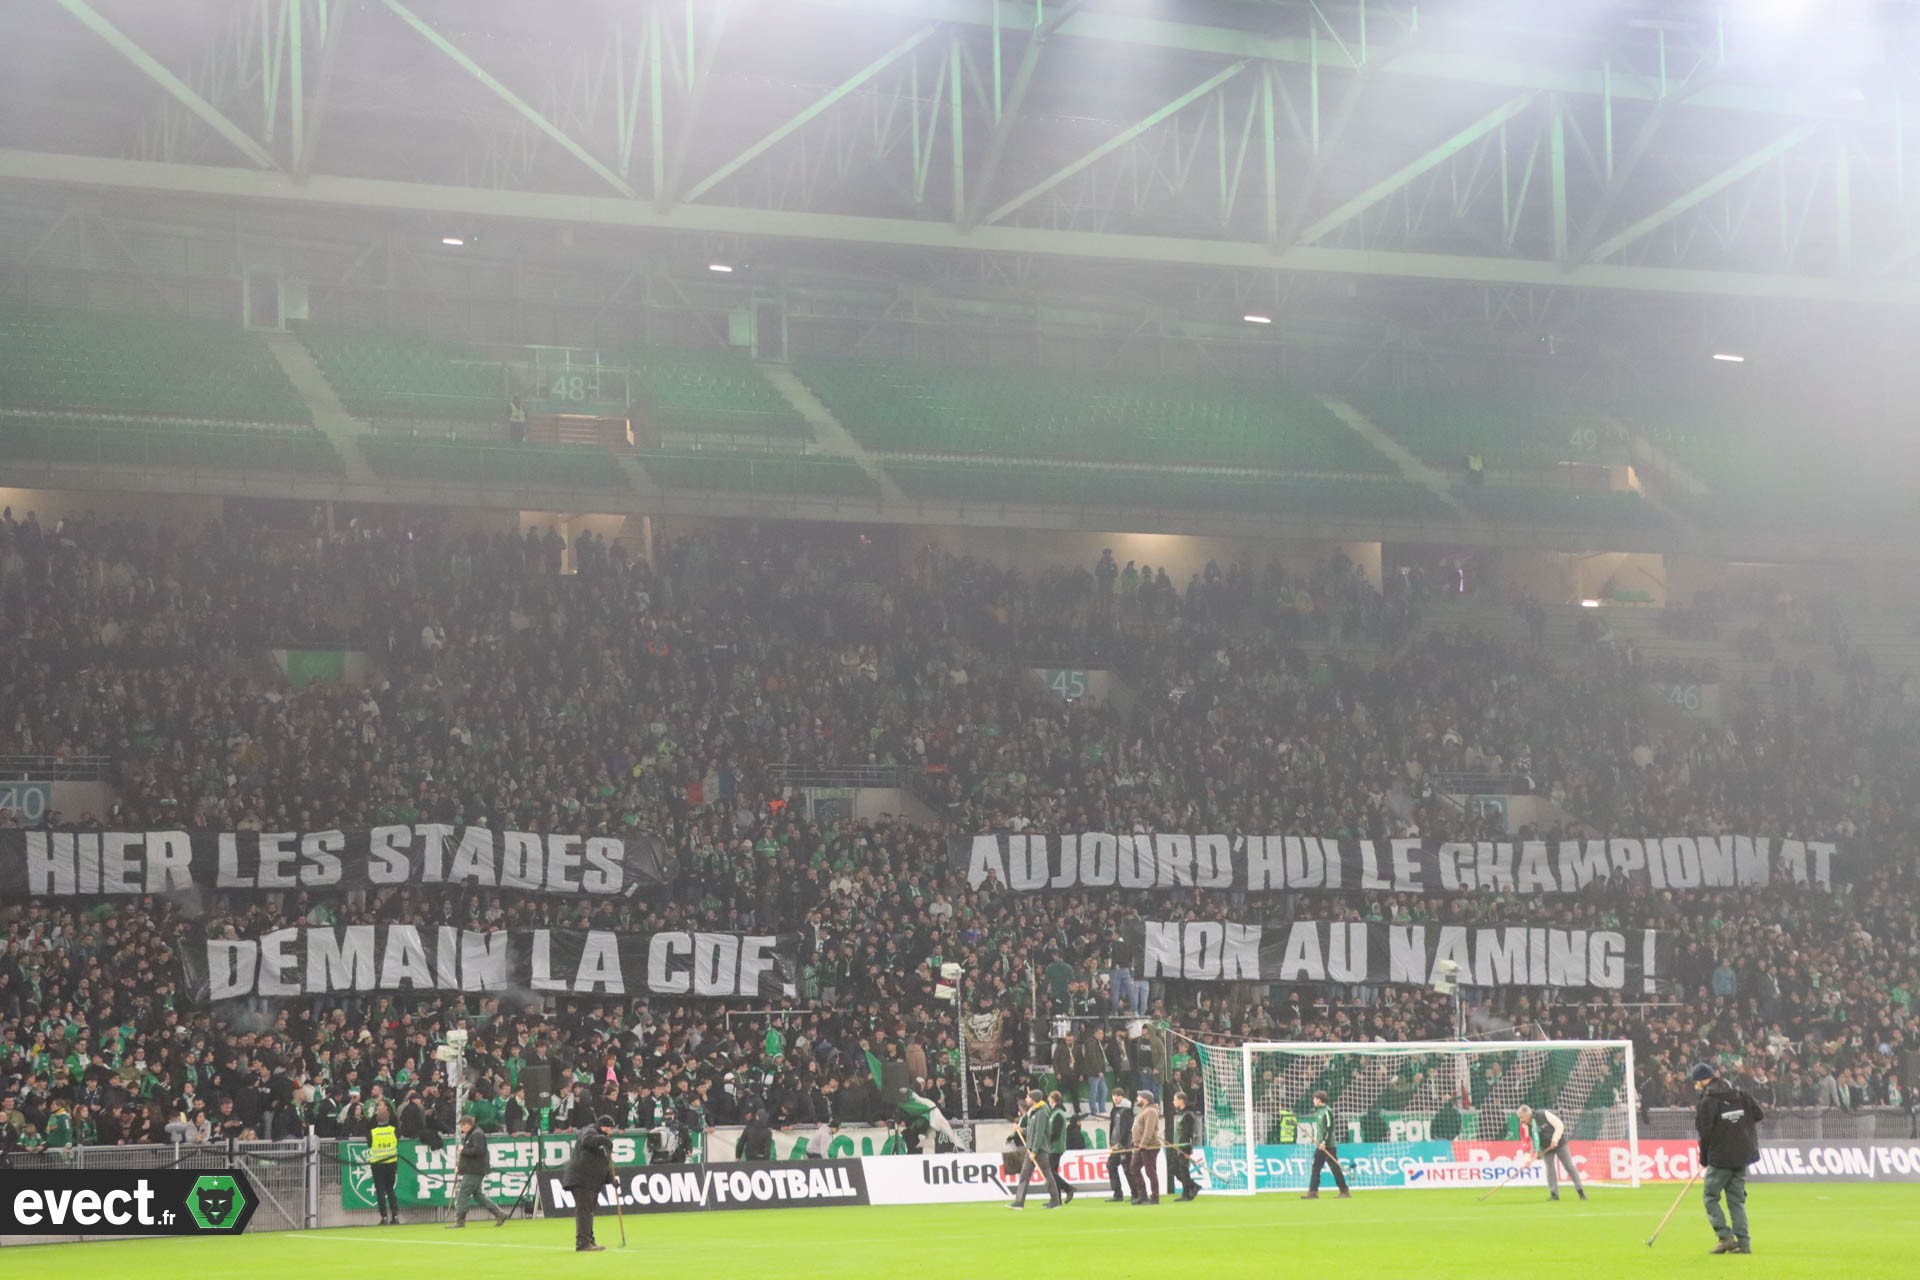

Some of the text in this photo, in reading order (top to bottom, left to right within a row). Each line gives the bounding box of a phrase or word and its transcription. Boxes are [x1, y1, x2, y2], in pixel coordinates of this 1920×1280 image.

[551, 376, 584, 400] 48
[1052, 671, 1085, 698] 45
[0, 787, 45, 819] 40
[26, 830, 193, 895] HIER
[217, 830, 342, 887] LES
[967, 830, 1342, 892] AUJOURD'HUI
[1361, 837, 1424, 893] LE
[207, 924, 507, 999] DEMAIN
[531, 929, 625, 993] LA
[1144, 921, 1657, 994] NON AU NAMING !
[415, 1138, 635, 1171] INERDS
[1427, 1166, 1542, 1180] INTERSPORT
[550, 1167, 857, 1208] NE.COM/FOOTBALL
